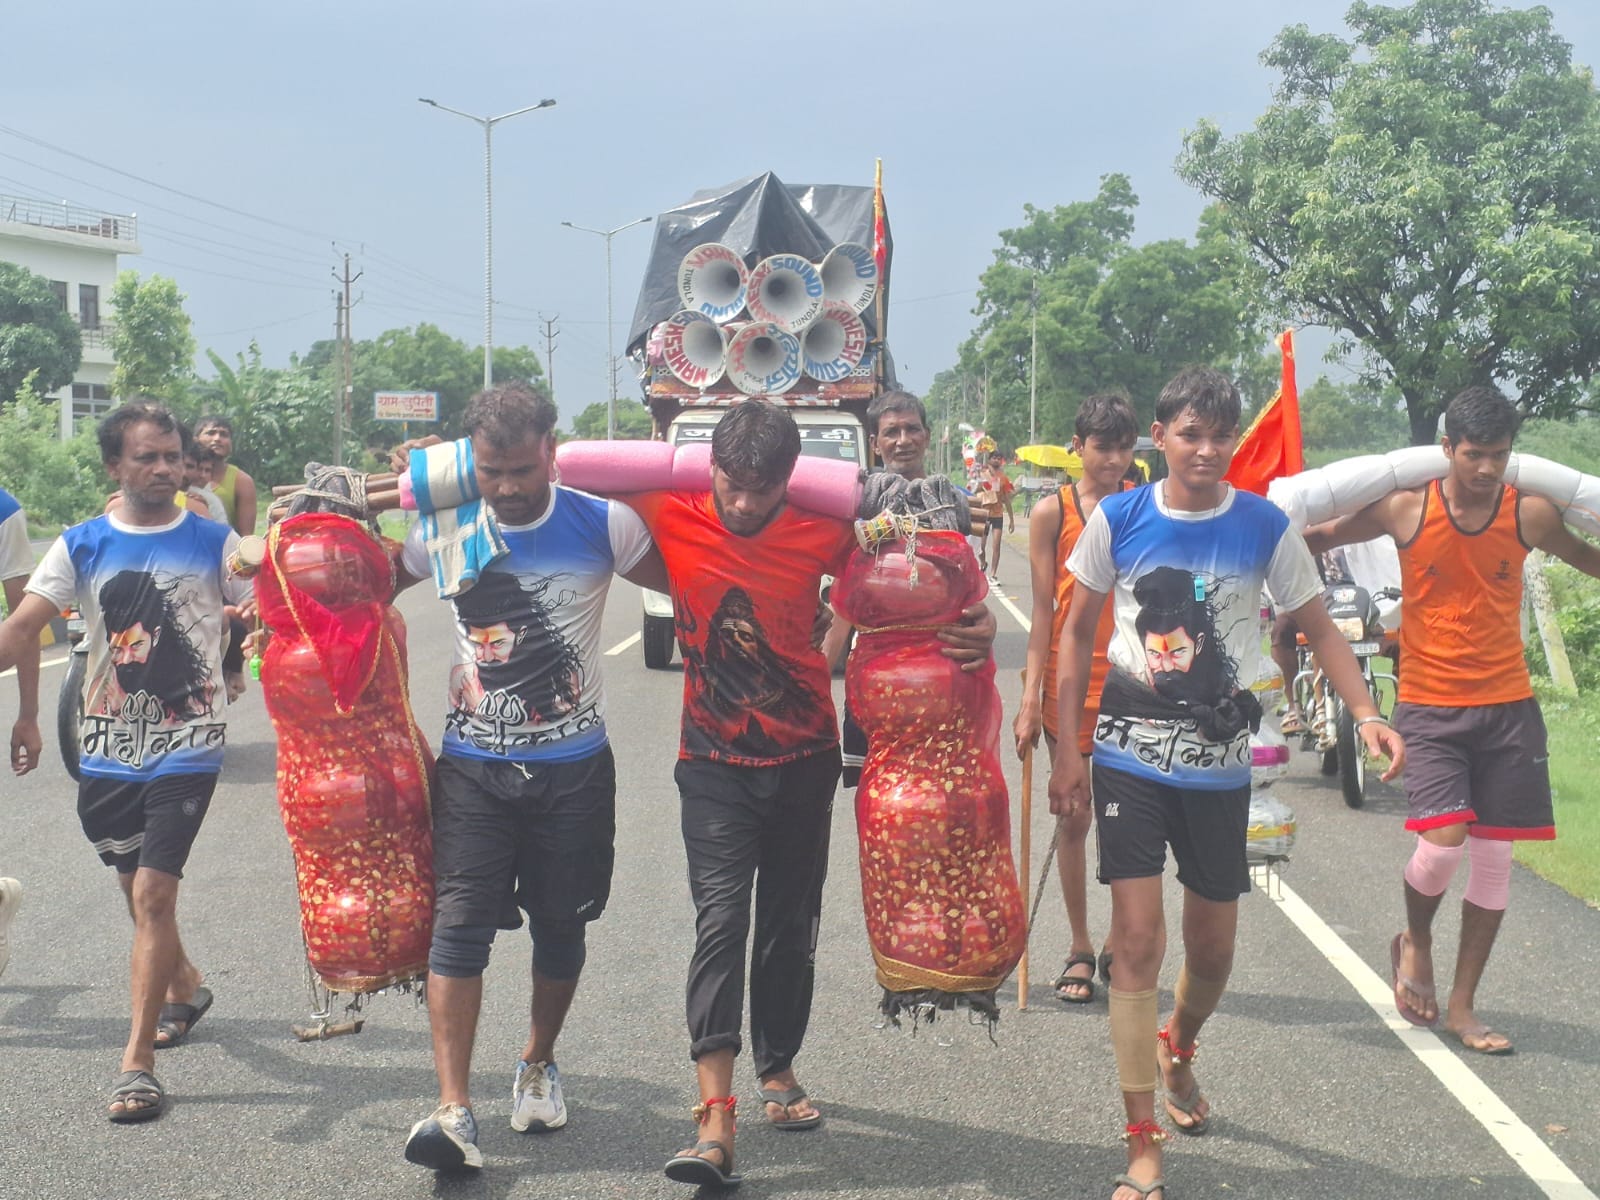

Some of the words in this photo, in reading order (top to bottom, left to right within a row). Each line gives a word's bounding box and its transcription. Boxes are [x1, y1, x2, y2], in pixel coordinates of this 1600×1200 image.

[683, 268, 694, 304] TUNDLA
[771, 258, 823, 297] SOUND
[854, 283, 875, 311] TUNDLA
[791, 302, 819, 328] TUNDLA
[664, 323, 708, 384] MAHESH
[825, 309, 865, 364] MAHESH
[83, 697, 227, 768] महाकाल
